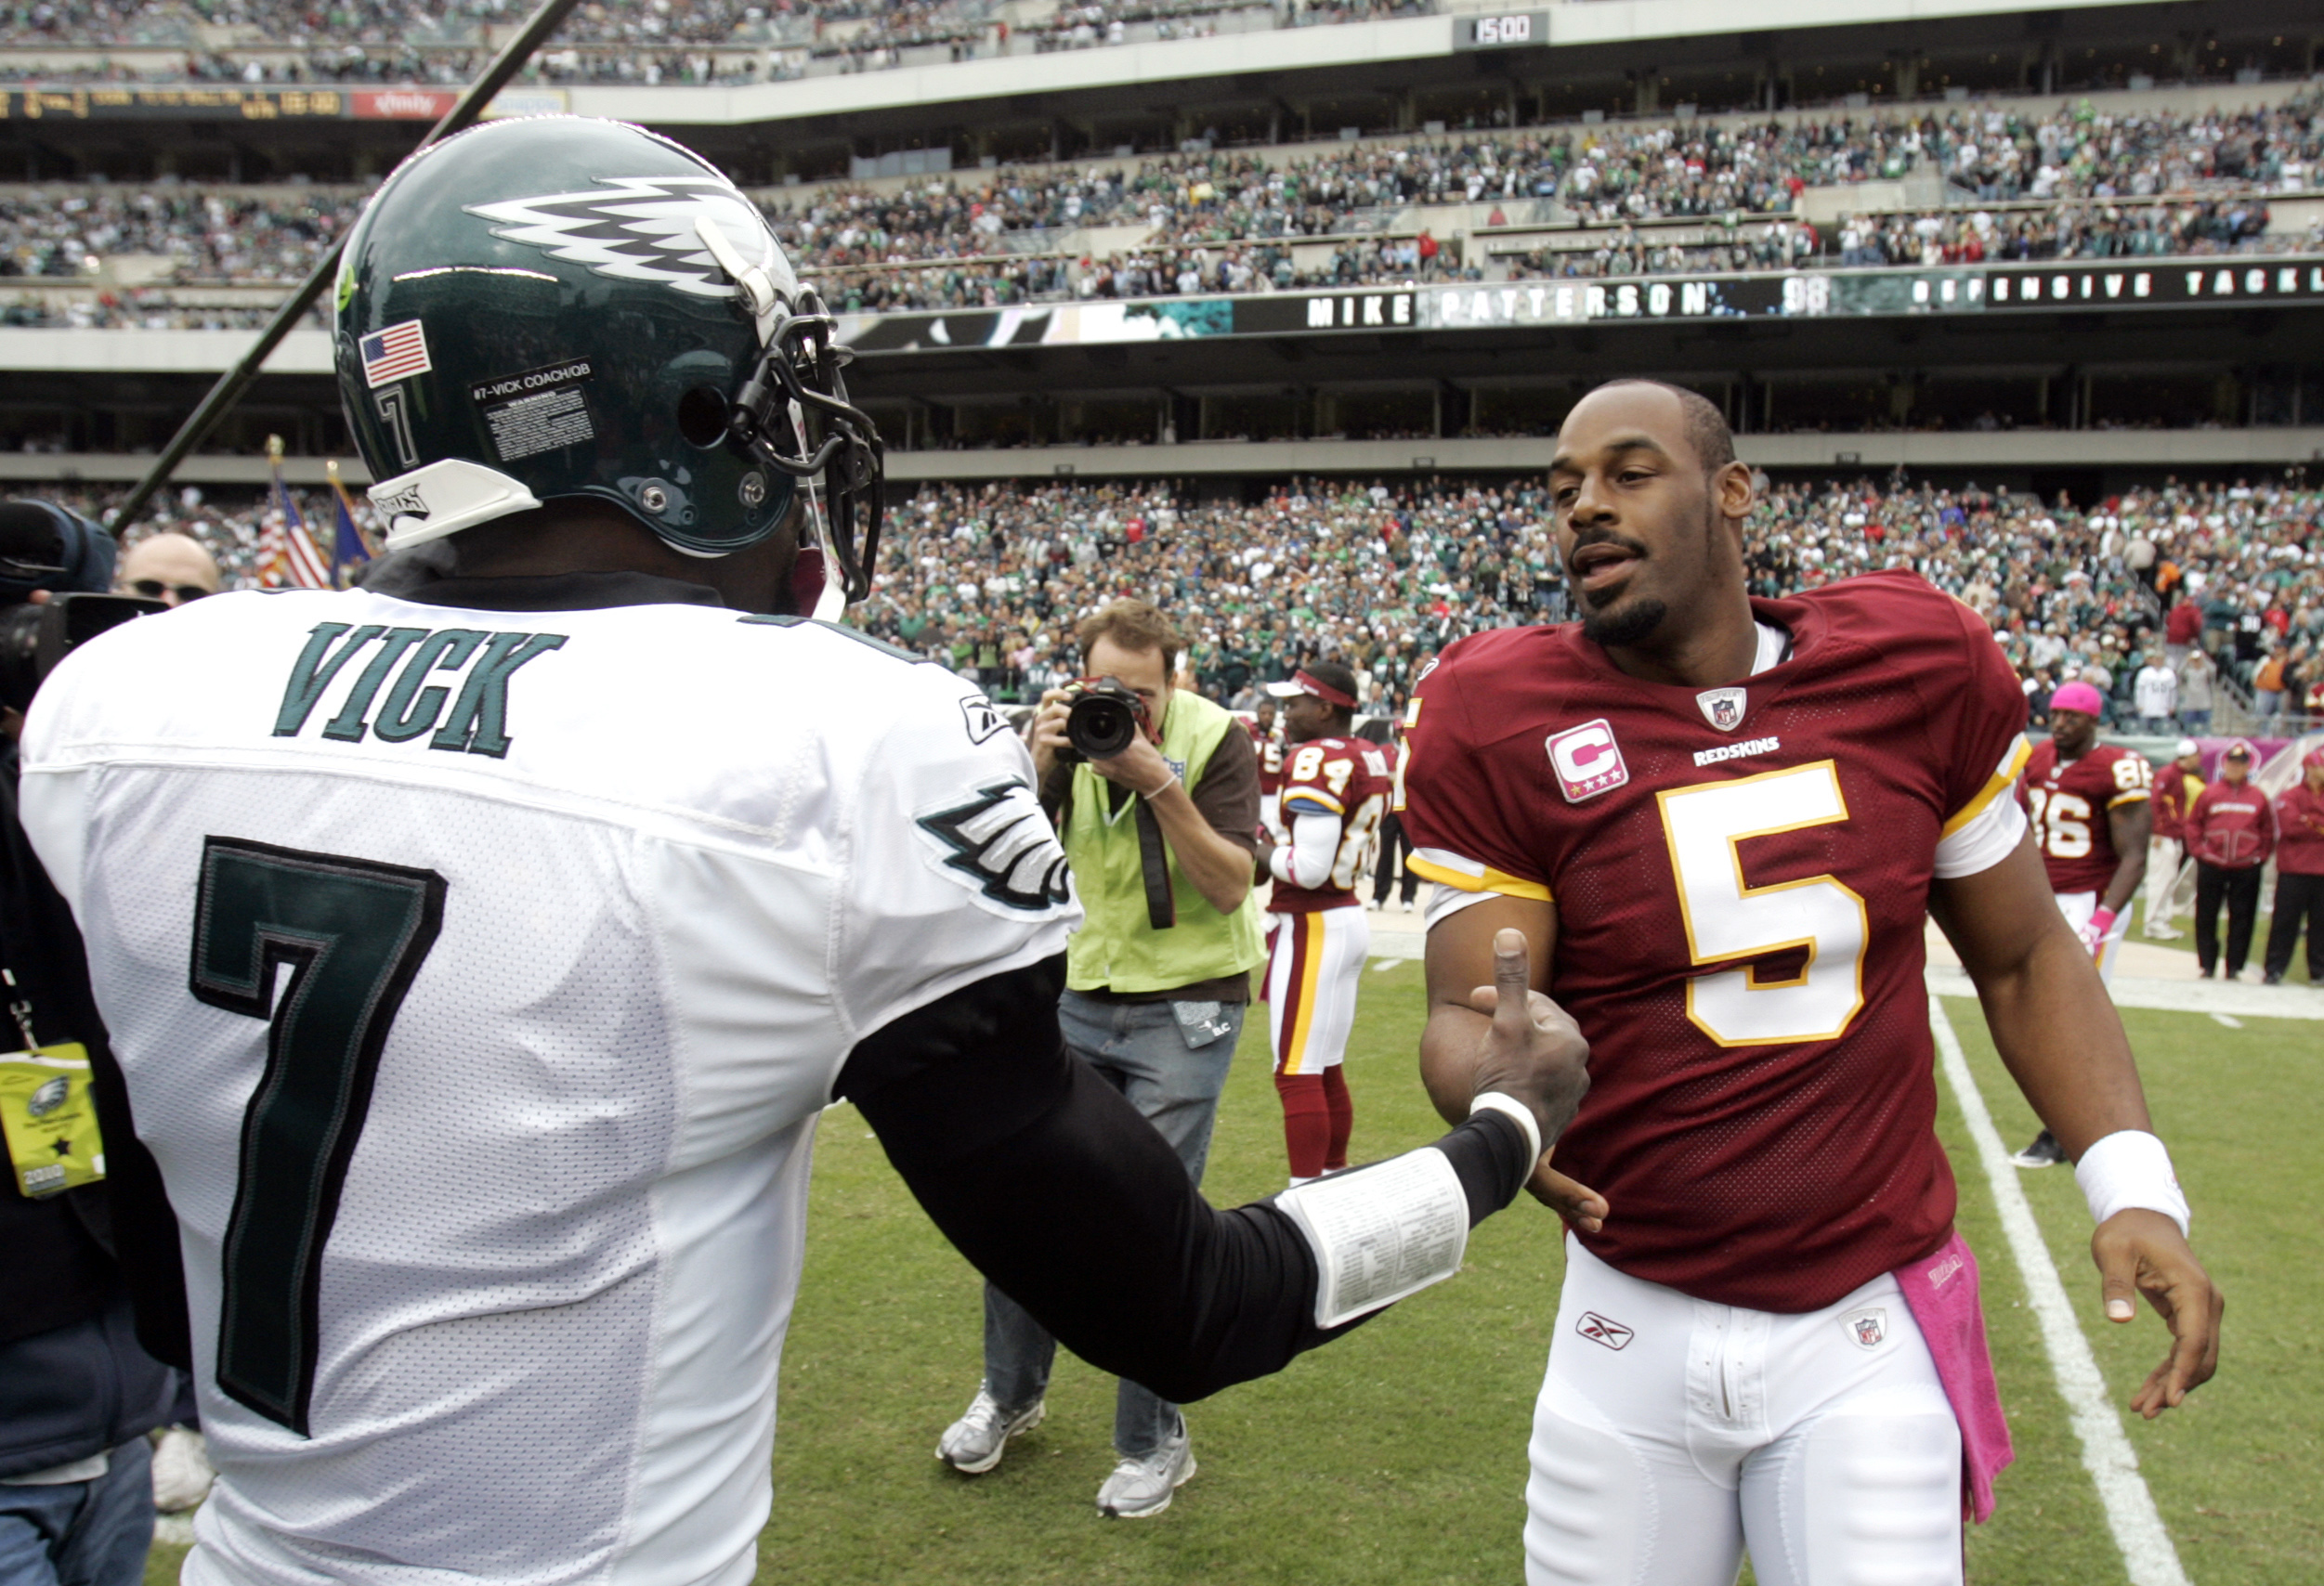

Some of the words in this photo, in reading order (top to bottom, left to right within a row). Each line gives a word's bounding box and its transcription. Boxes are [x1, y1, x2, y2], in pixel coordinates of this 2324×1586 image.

[1307, 293, 1411, 328] MIKE
[1441, 281, 1706, 319] PATTERSON
[523, 363, 591, 388] COACH/QB
[374, 384, 420, 469] 7
[269, 621, 570, 760] VICK
[1291, 746, 1354, 796] 84
[1554, 728, 1617, 783] C
[1692, 735, 1781, 767] REDSKINS
[1654, 759, 1870, 1047] 5
[189, 835, 449, 1439] 7
